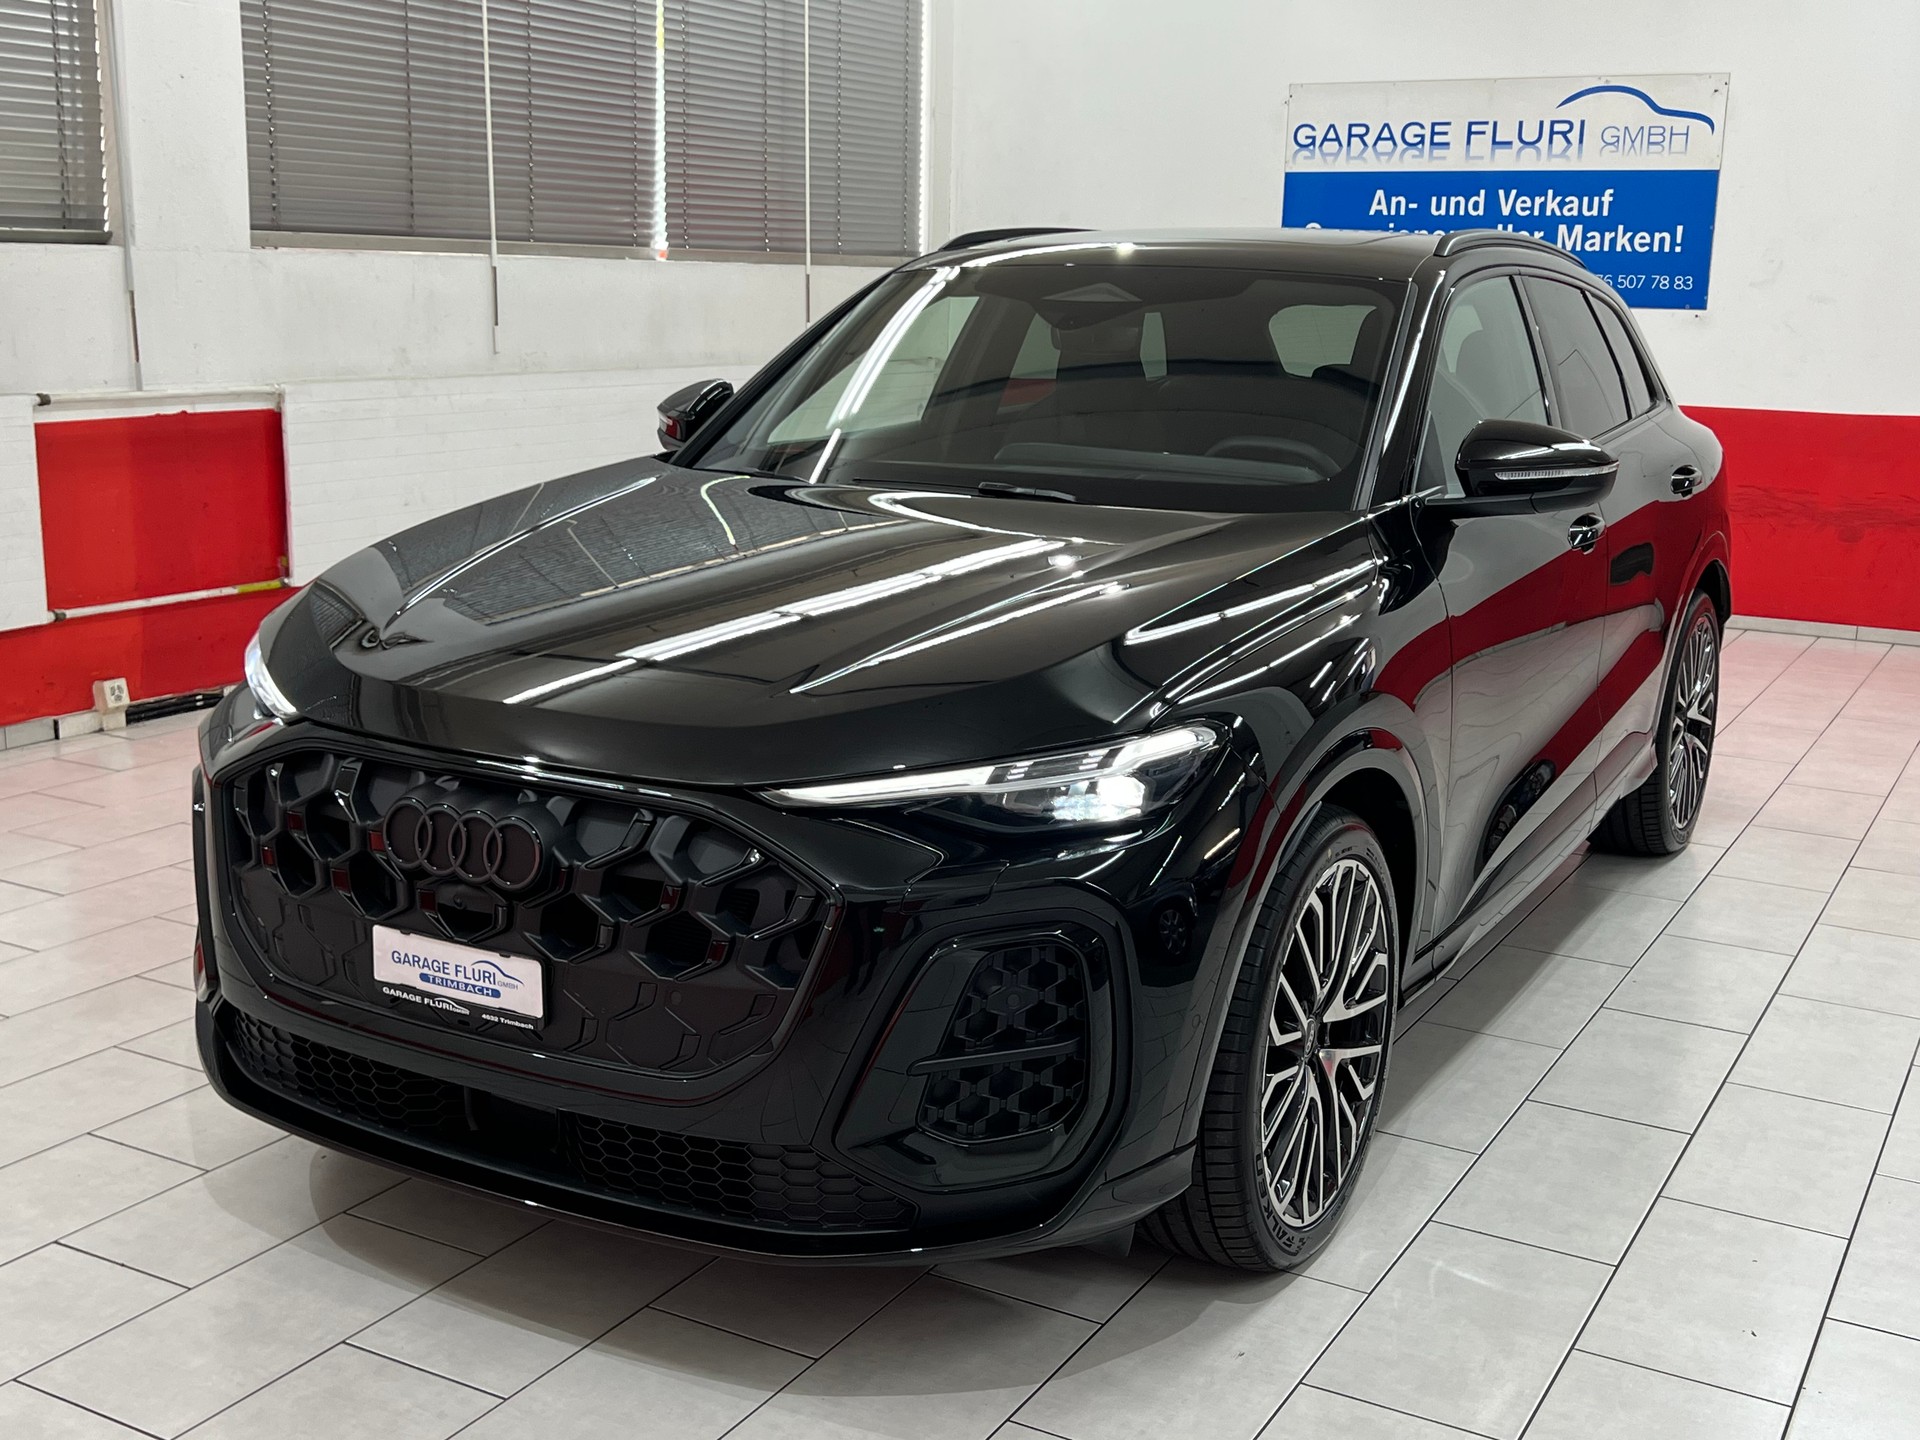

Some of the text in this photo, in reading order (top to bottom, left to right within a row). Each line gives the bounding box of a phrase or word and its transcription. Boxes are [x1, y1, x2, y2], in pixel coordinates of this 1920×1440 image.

[1293, 119, 1690, 149] GARAGE FLURI GMBH
[1369, 189, 1614, 218] An- und Verkauf
[1556, 224, 1684, 253] Marken!
[1617, 274, 1646, 289] 507
[1651, 275, 1670, 290] 78
[1673, 276, 1693, 290] 83
[391, 950, 450, 975] GARAGE
[454, 964, 496, 985] FLURI
[382, 986, 422, 1004] GARAGE
[424, 998, 453, 1011] FLURI
[427, 974, 493, 997] TRIMBACH
[499, 1017, 534, 1030] Trimbach
